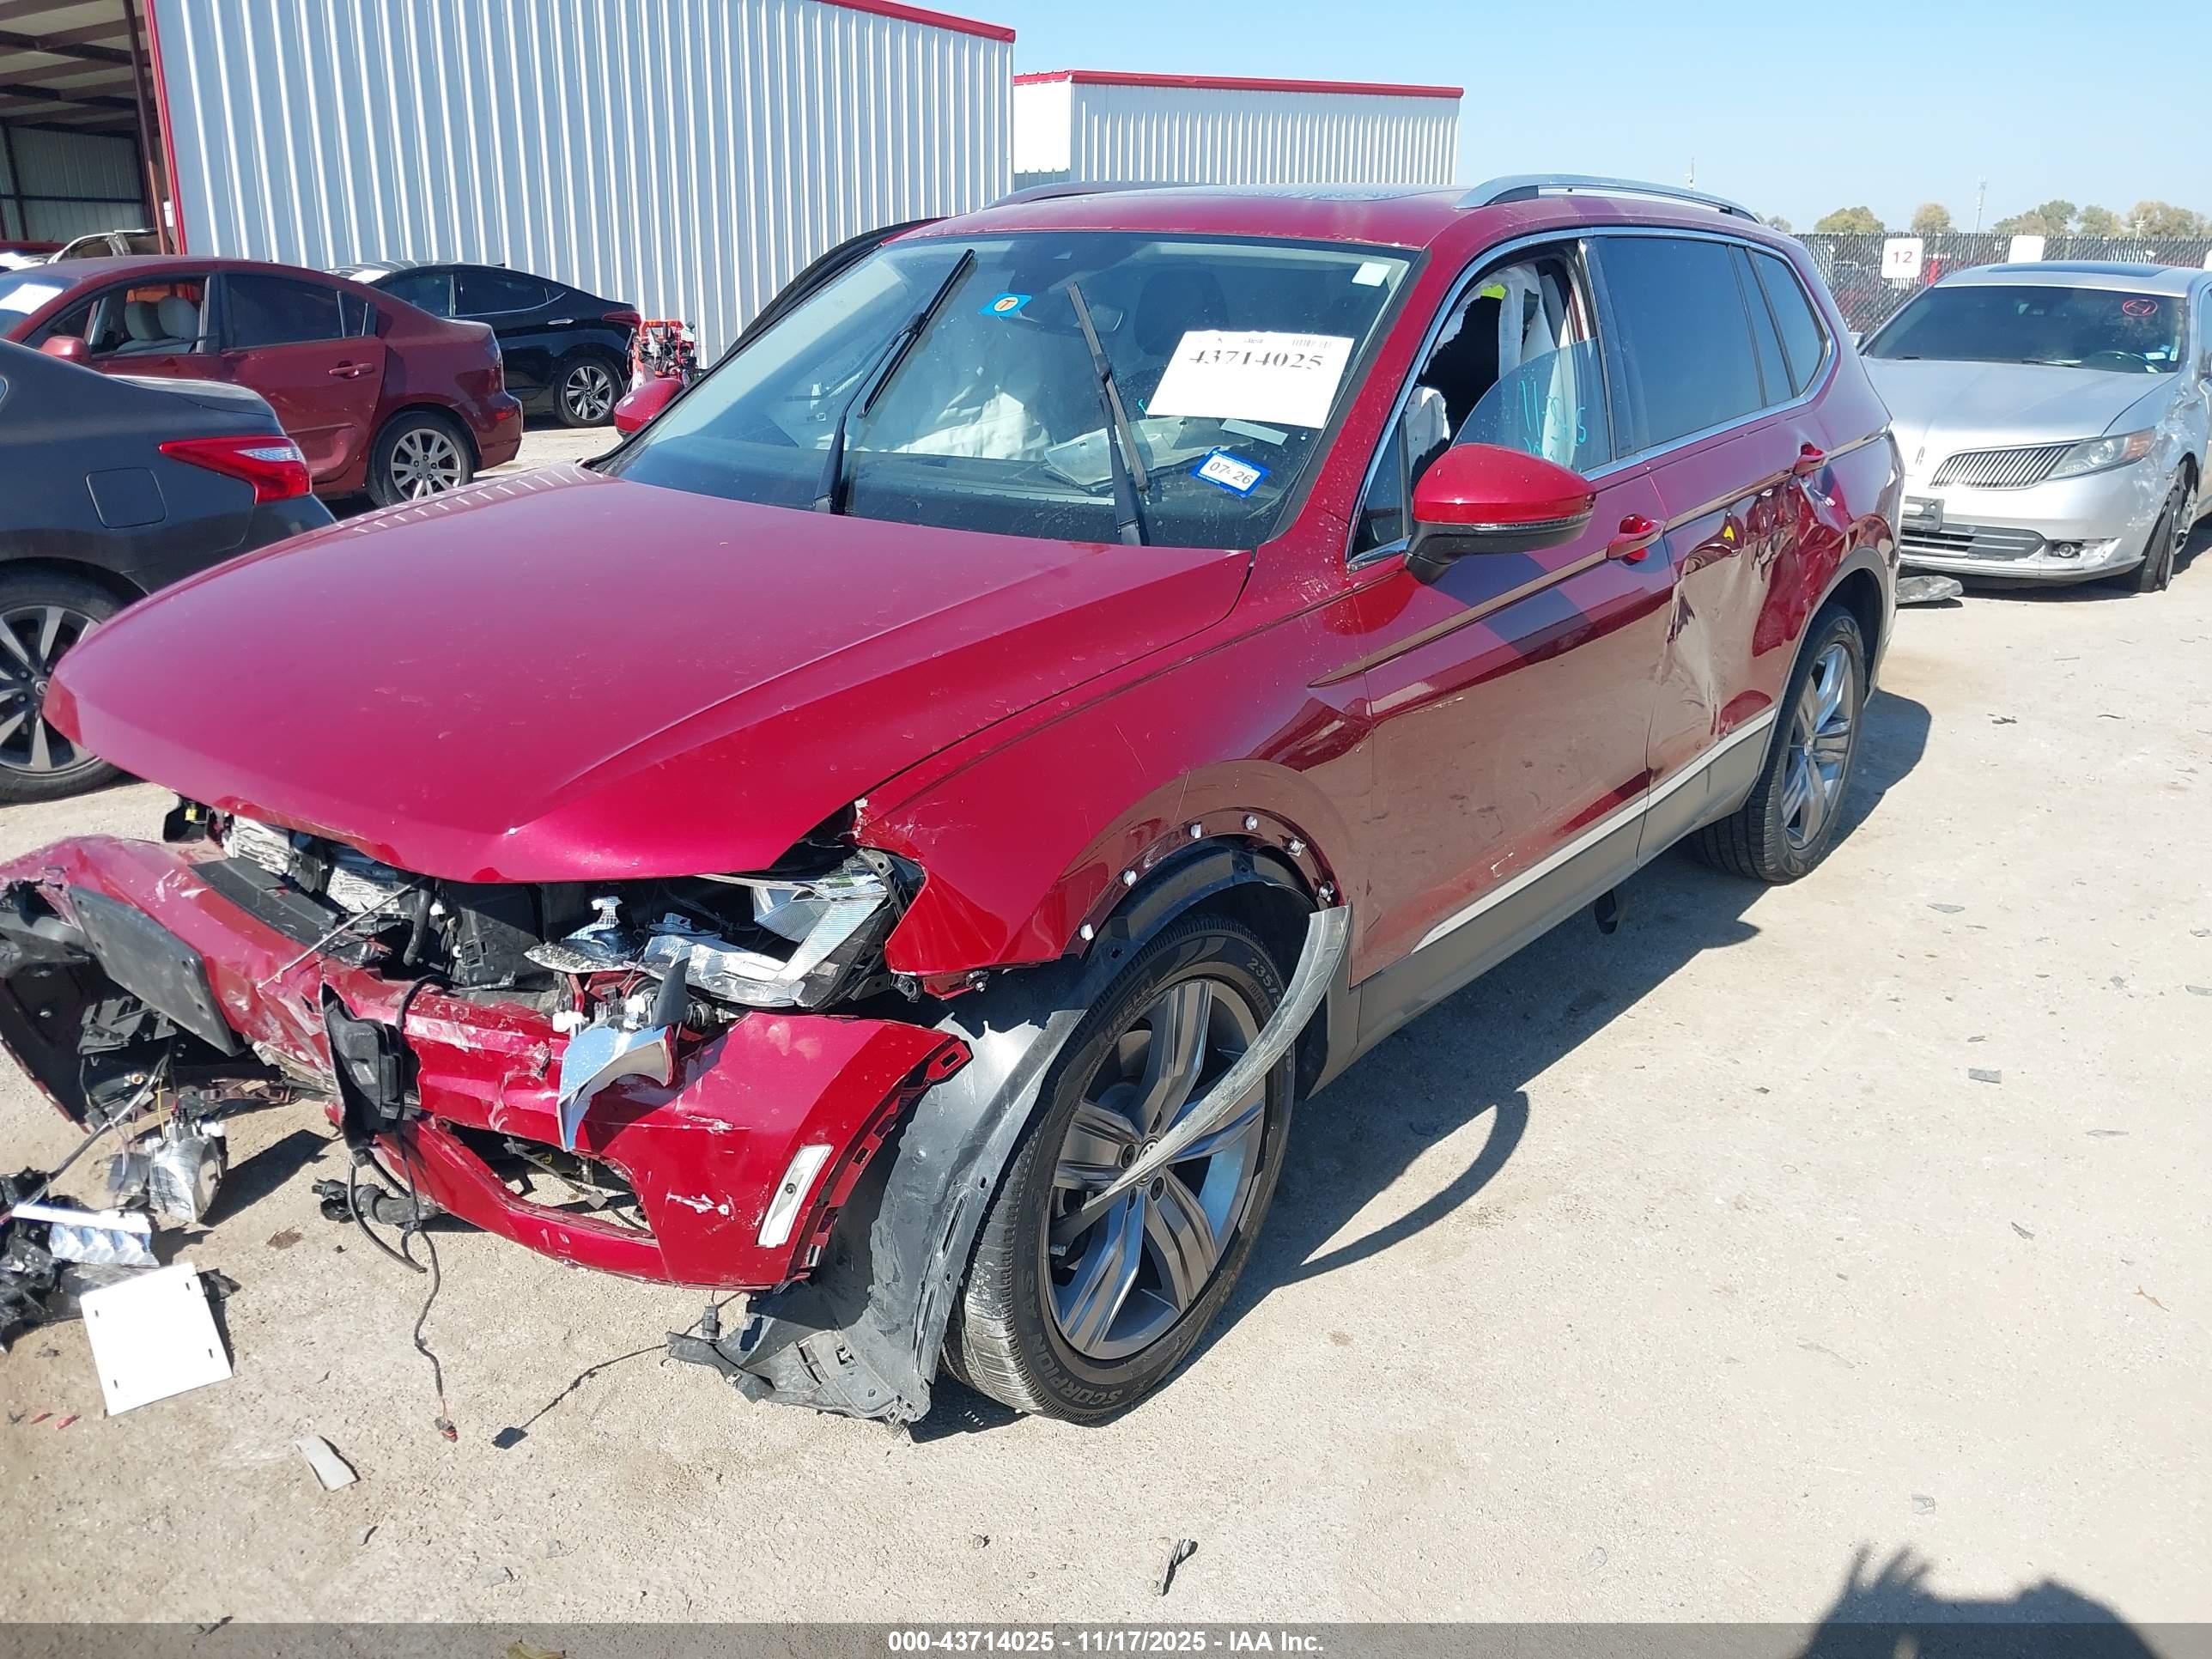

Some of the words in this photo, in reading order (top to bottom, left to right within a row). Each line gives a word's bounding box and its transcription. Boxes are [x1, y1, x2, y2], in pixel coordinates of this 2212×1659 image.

[1892, 250, 1914, 264] 12
[1188, 349, 1325, 370] 43714025
[1030, 1333, 1123, 1407] SCORPION
